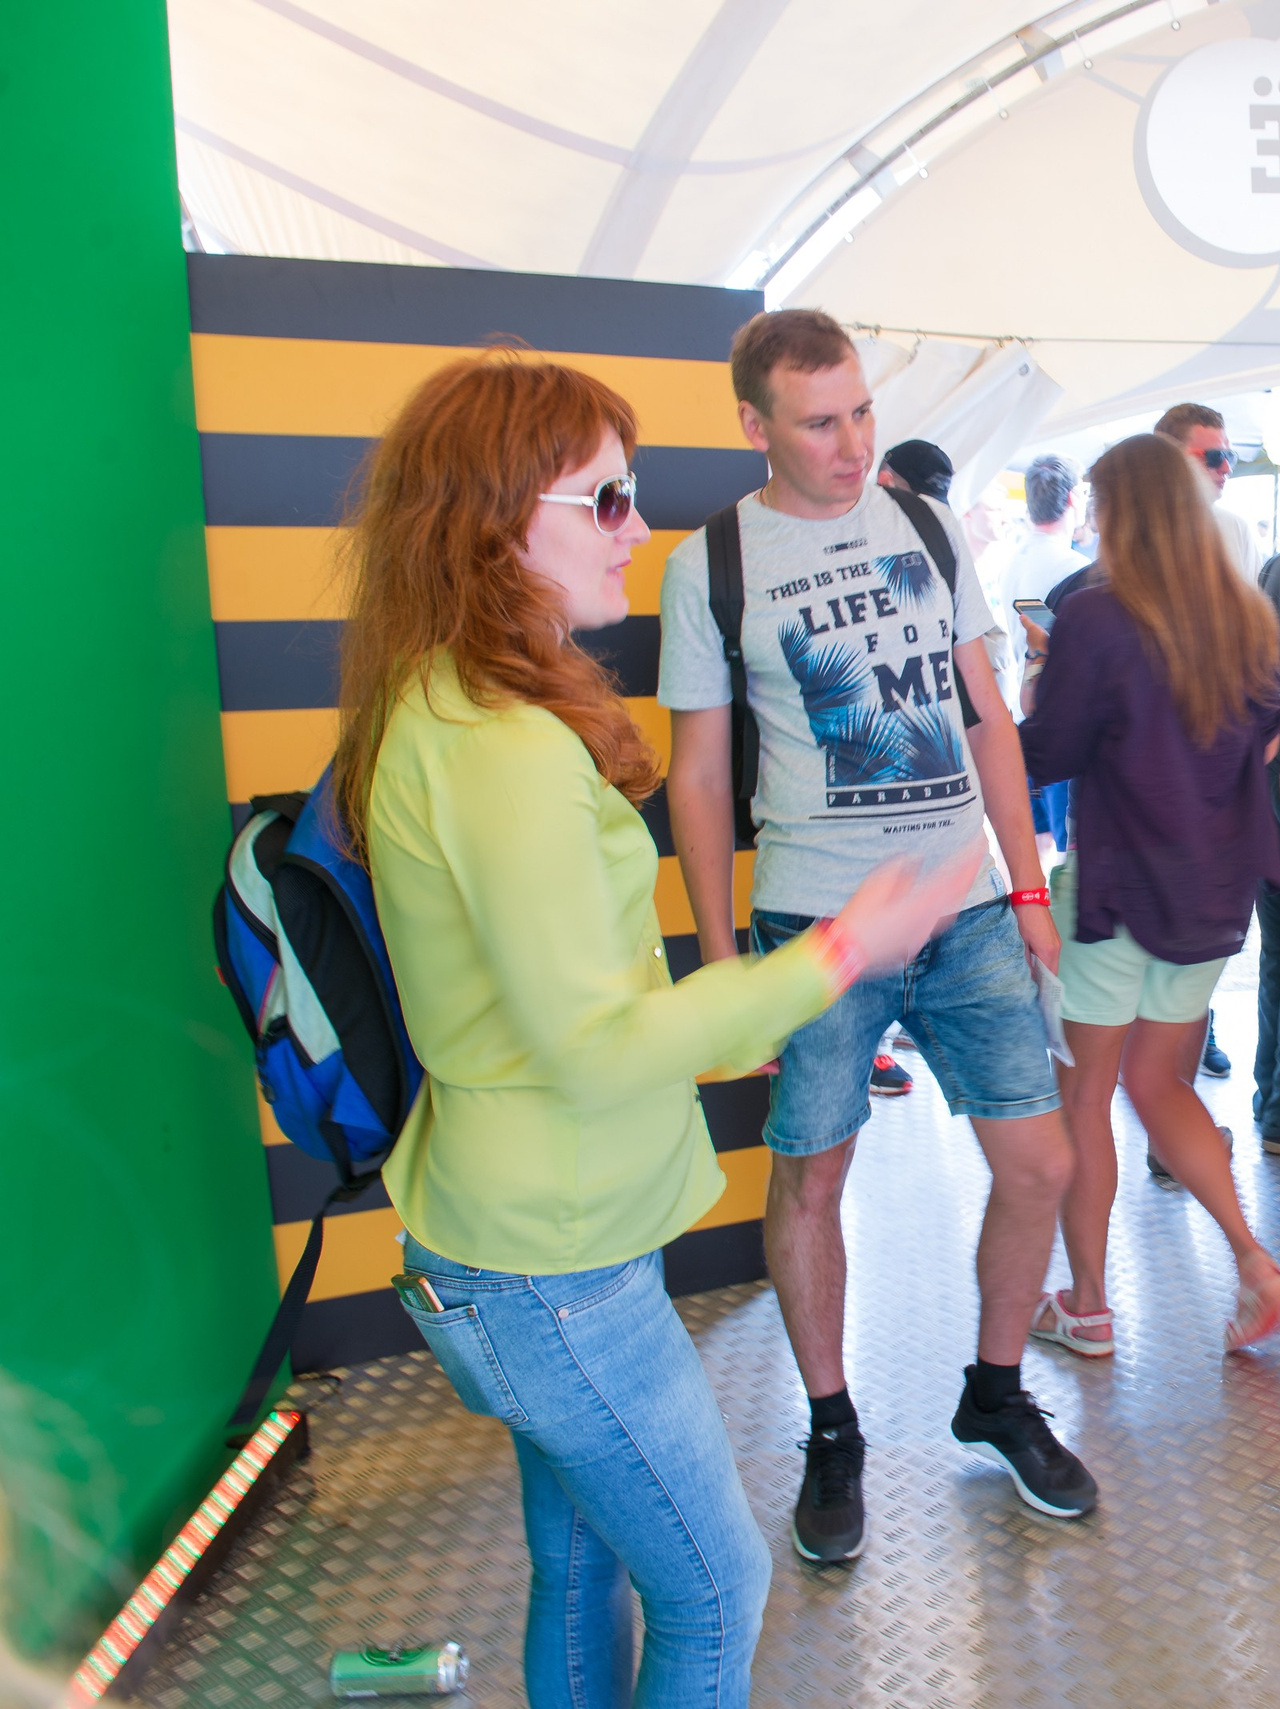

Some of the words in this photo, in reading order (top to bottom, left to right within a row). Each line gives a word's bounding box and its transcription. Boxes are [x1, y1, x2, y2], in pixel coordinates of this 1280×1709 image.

[766, 577, 811, 602] THIS
[813, 571, 834, 588] IS
[836, 561, 872, 581] THE
[799, 587, 898, 636] LIFE
[872, 650, 952, 713] ME
[828, 779, 970, 805] PARADISE
[882, 823, 921, 835] WAITING
